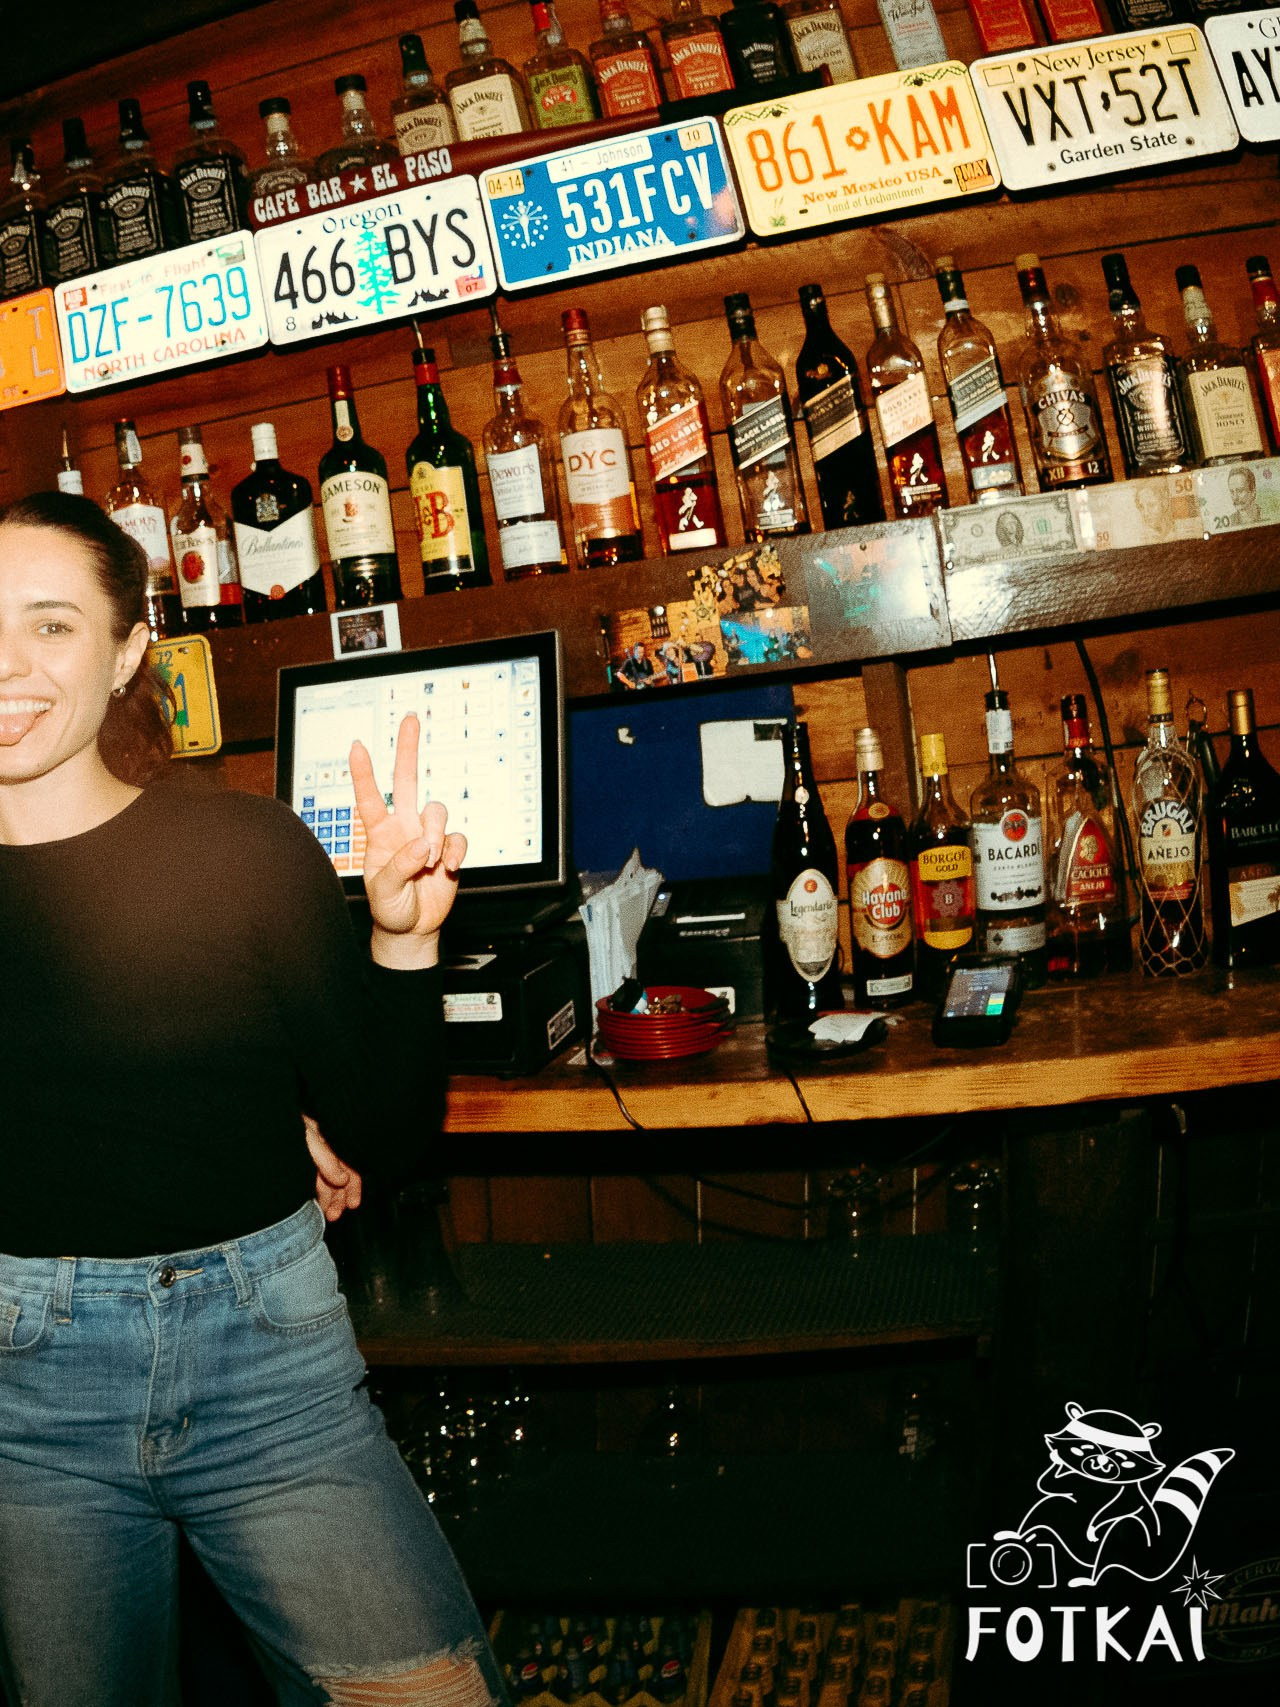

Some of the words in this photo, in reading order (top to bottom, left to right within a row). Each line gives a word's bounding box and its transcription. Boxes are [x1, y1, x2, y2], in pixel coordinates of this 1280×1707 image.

[671, 46, 690, 66] JACK
[1032, 56, 1083, 77] New
[1085, 43, 1149, 71] Jersey
[599, 64, 618, 84] JACK
[1232, 50, 1280, 108] AY
[456, 98, 476, 115] JACK
[397, 122, 415, 139] JACK
[685, 128, 700, 142] 10
[746, 113, 848, 194] 861
[867, 85, 972, 166] KAM
[596, 142, 644, 167] Johnson
[1060, 141, 1125, 165] Garden
[1129, 131, 1179, 151] State
[962, 159, 992, 182] MAY
[253, 188, 300, 223] CAFE
[305, 176, 346, 209] BAR
[371, 162, 399, 192] EL
[404, 148, 453, 183] PASO
[556, 151, 715, 241] 531FCV
[803, 190, 841, 207] New
[842, 175, 903, 199] Mexico
[906, 164, 944, 186] USA
[322, 203, 403, 234] Oregon
[567, 226, 669, 265] INDIANA
[274, 237, 356, 310] 466
[384, 208, 476, 285] BYS
[67, 266, 251, 365] DZF-7639
[83, 353, 145, 381] NORTH
[153, 327, 247, 364] CAROLINA
[1038, 389, 1086, 409] CHIVAS
[1200, 382, 1218, 397] JACK
[568, 448, 617, 473] DYC
[1087, 461, 1100, 474] 12
[322, 478, 381, 505] JAMESON
[1174, 478, 1194, 493] 50
[1213, 515, 1231, 530] 20
[1140, 799, 1196, 839] BRUGAL
[1147, 842, 1191, 862] AÑEJO
[935, 863, 959, 873] GOLD
[862, 889, 908, 905] Havana
[871, 904, 901, 920] Club
